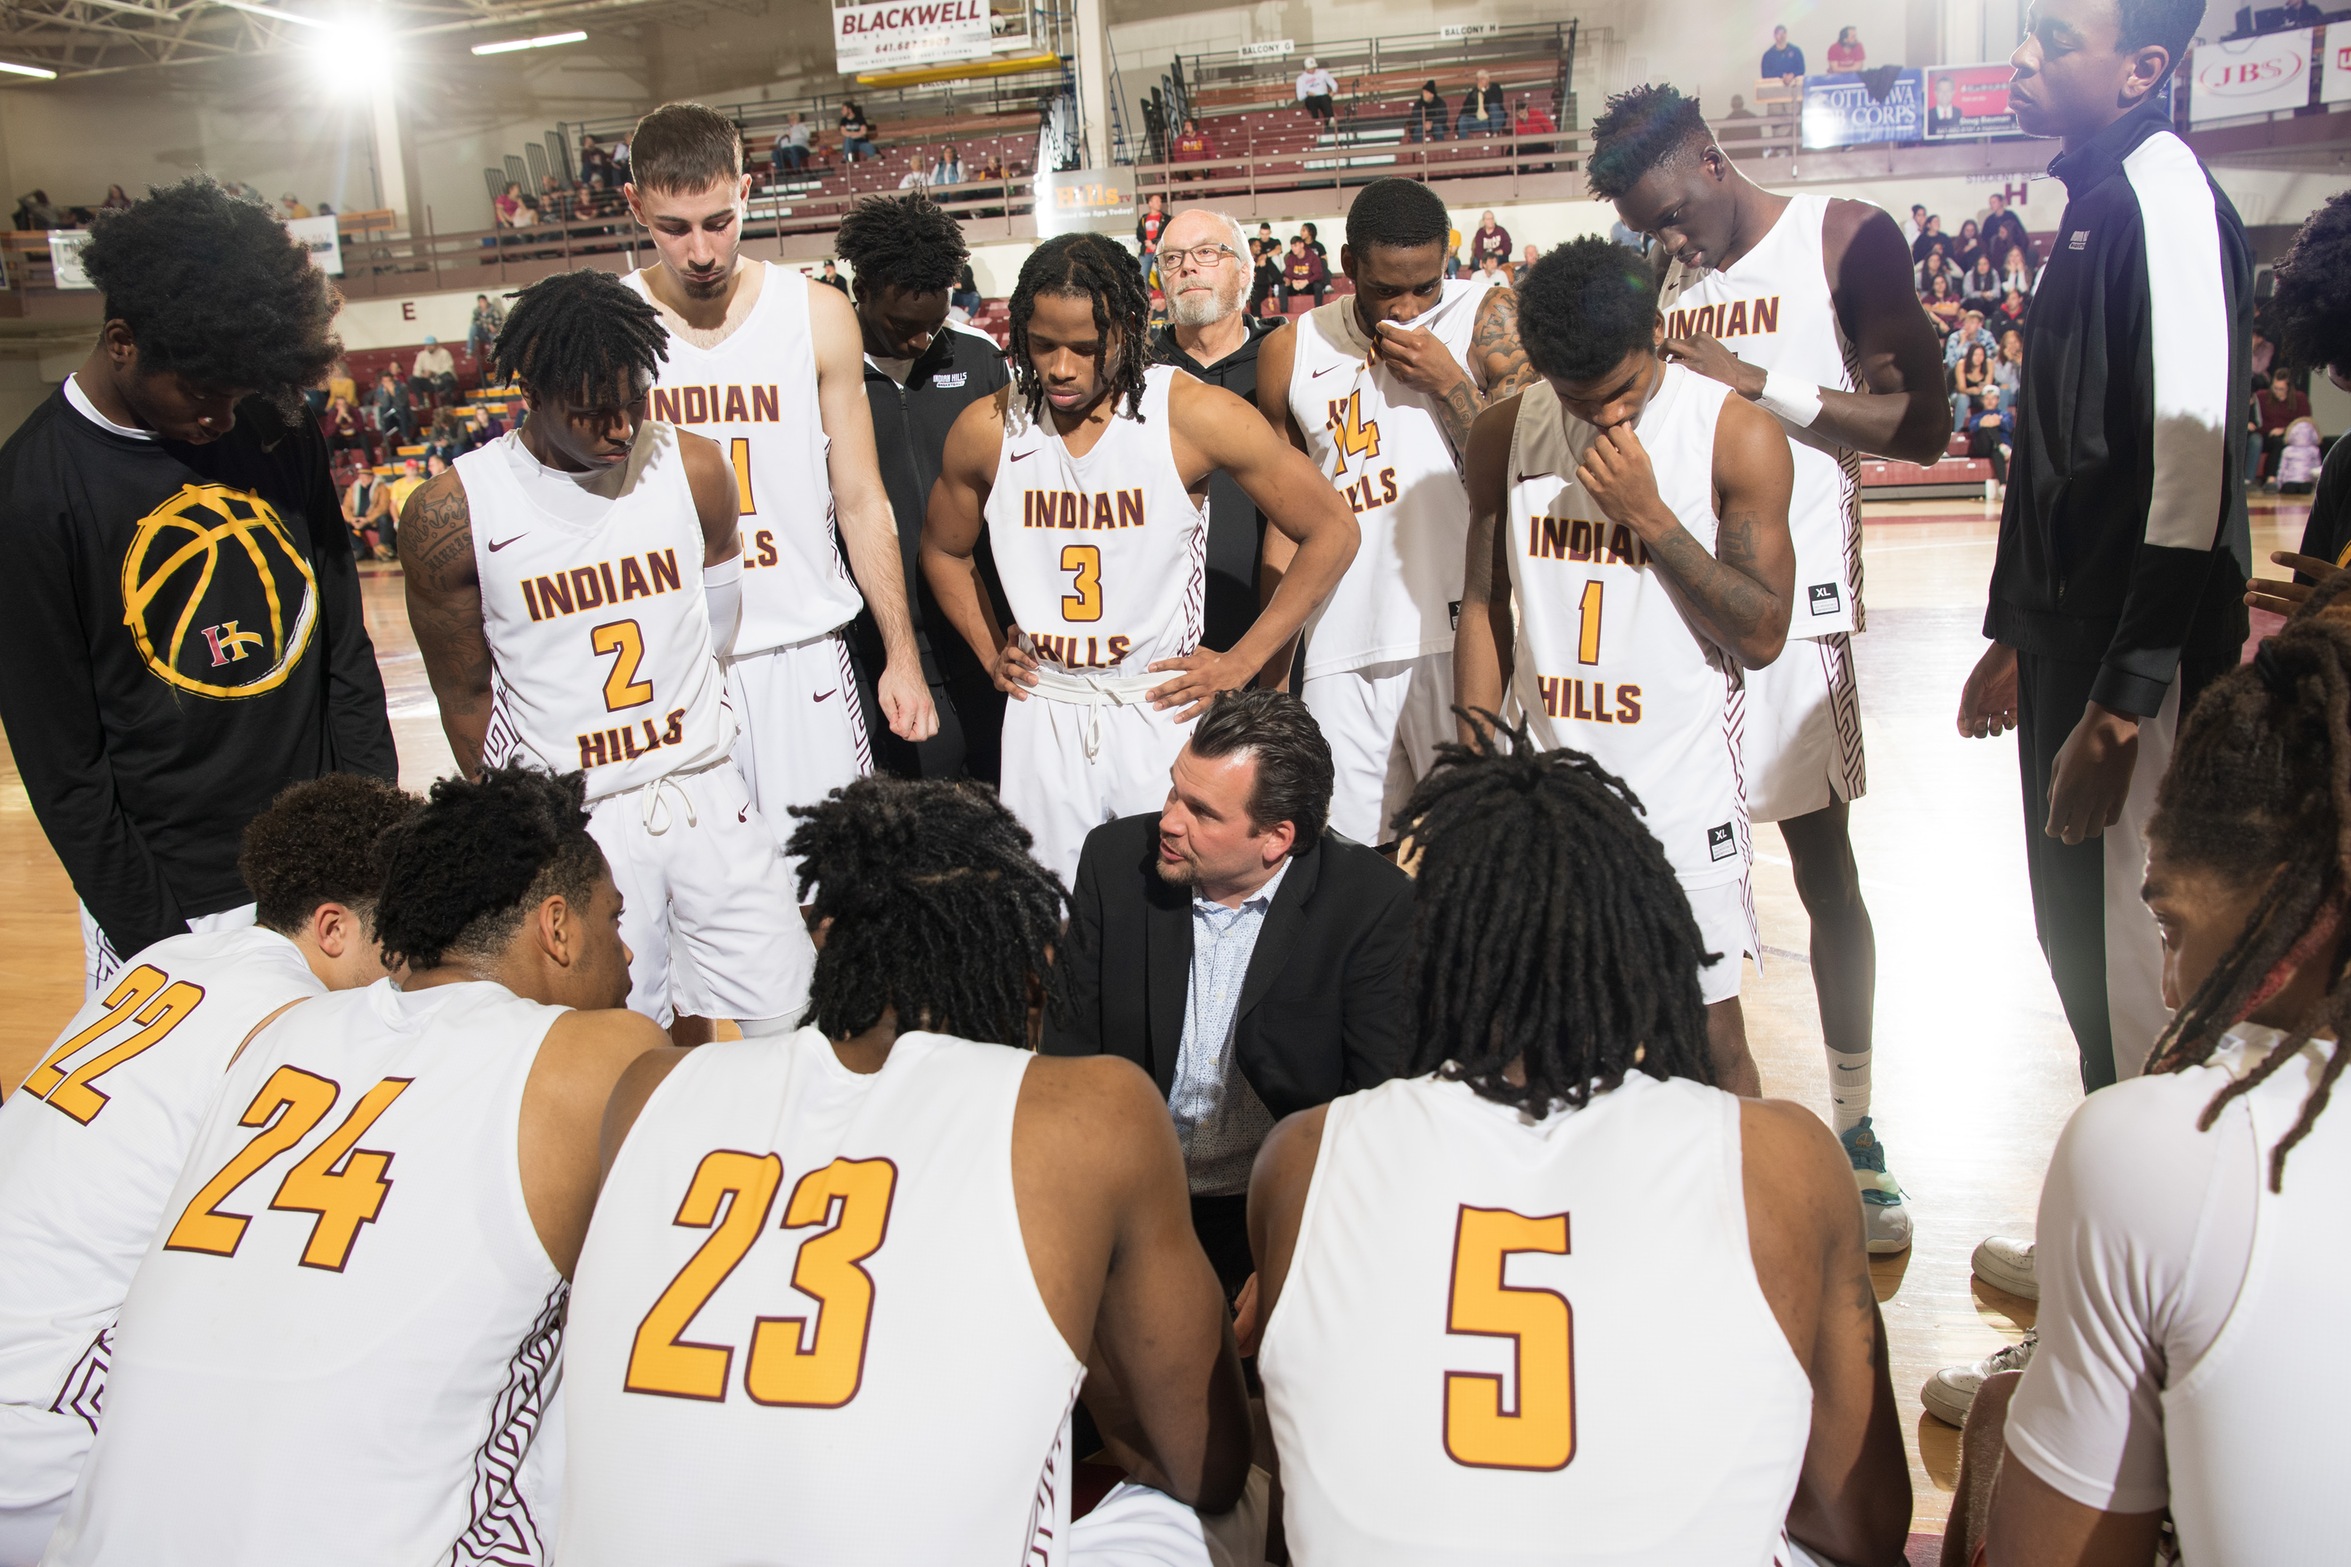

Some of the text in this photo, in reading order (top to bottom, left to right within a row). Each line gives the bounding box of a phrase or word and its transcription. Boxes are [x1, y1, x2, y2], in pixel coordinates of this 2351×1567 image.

[842, 0, 981, 35] BLACKWELL
[1445, 24, 1496, 36] BALCONY H
[1242, 42, 1291, 55] BALCONY G
[2214, 58, 2282, 87] JBS
[1830, 85, 1915, 108] OTTUWA
[1851, 104, 1916, 126] CORPS
[2005, 183, 2027, 206] H
[402, 302, 416, 321] E
[1667, 296, 1780, 339] INDIAN
[952, 371, 967, 382] HILLS
[644, 384, 780, 425] INDIAN
[1024, 488, 1145, 531] INDIAN
[520, 548, 681, 622] INDIAN
[1060, 545, 1103, 623] 3
[1815, 587, 1831, 598] XL
[1578, 580, 1604, 666] 1
[590, 618, 654, 712] 2
[1029, 632, 1131, 669] HILLS
[1537, 674, 1642, 724] HILLS
[577, 707, 686, 768] HILLS
[1715, 829, 1727, 841] XL
[22, 963, 205, 1126] 22
[162, 1064, 415, 1273] 24
[623, 1148, 898, 1409] 23
[1443, 1203, 1577, 1473] 5
